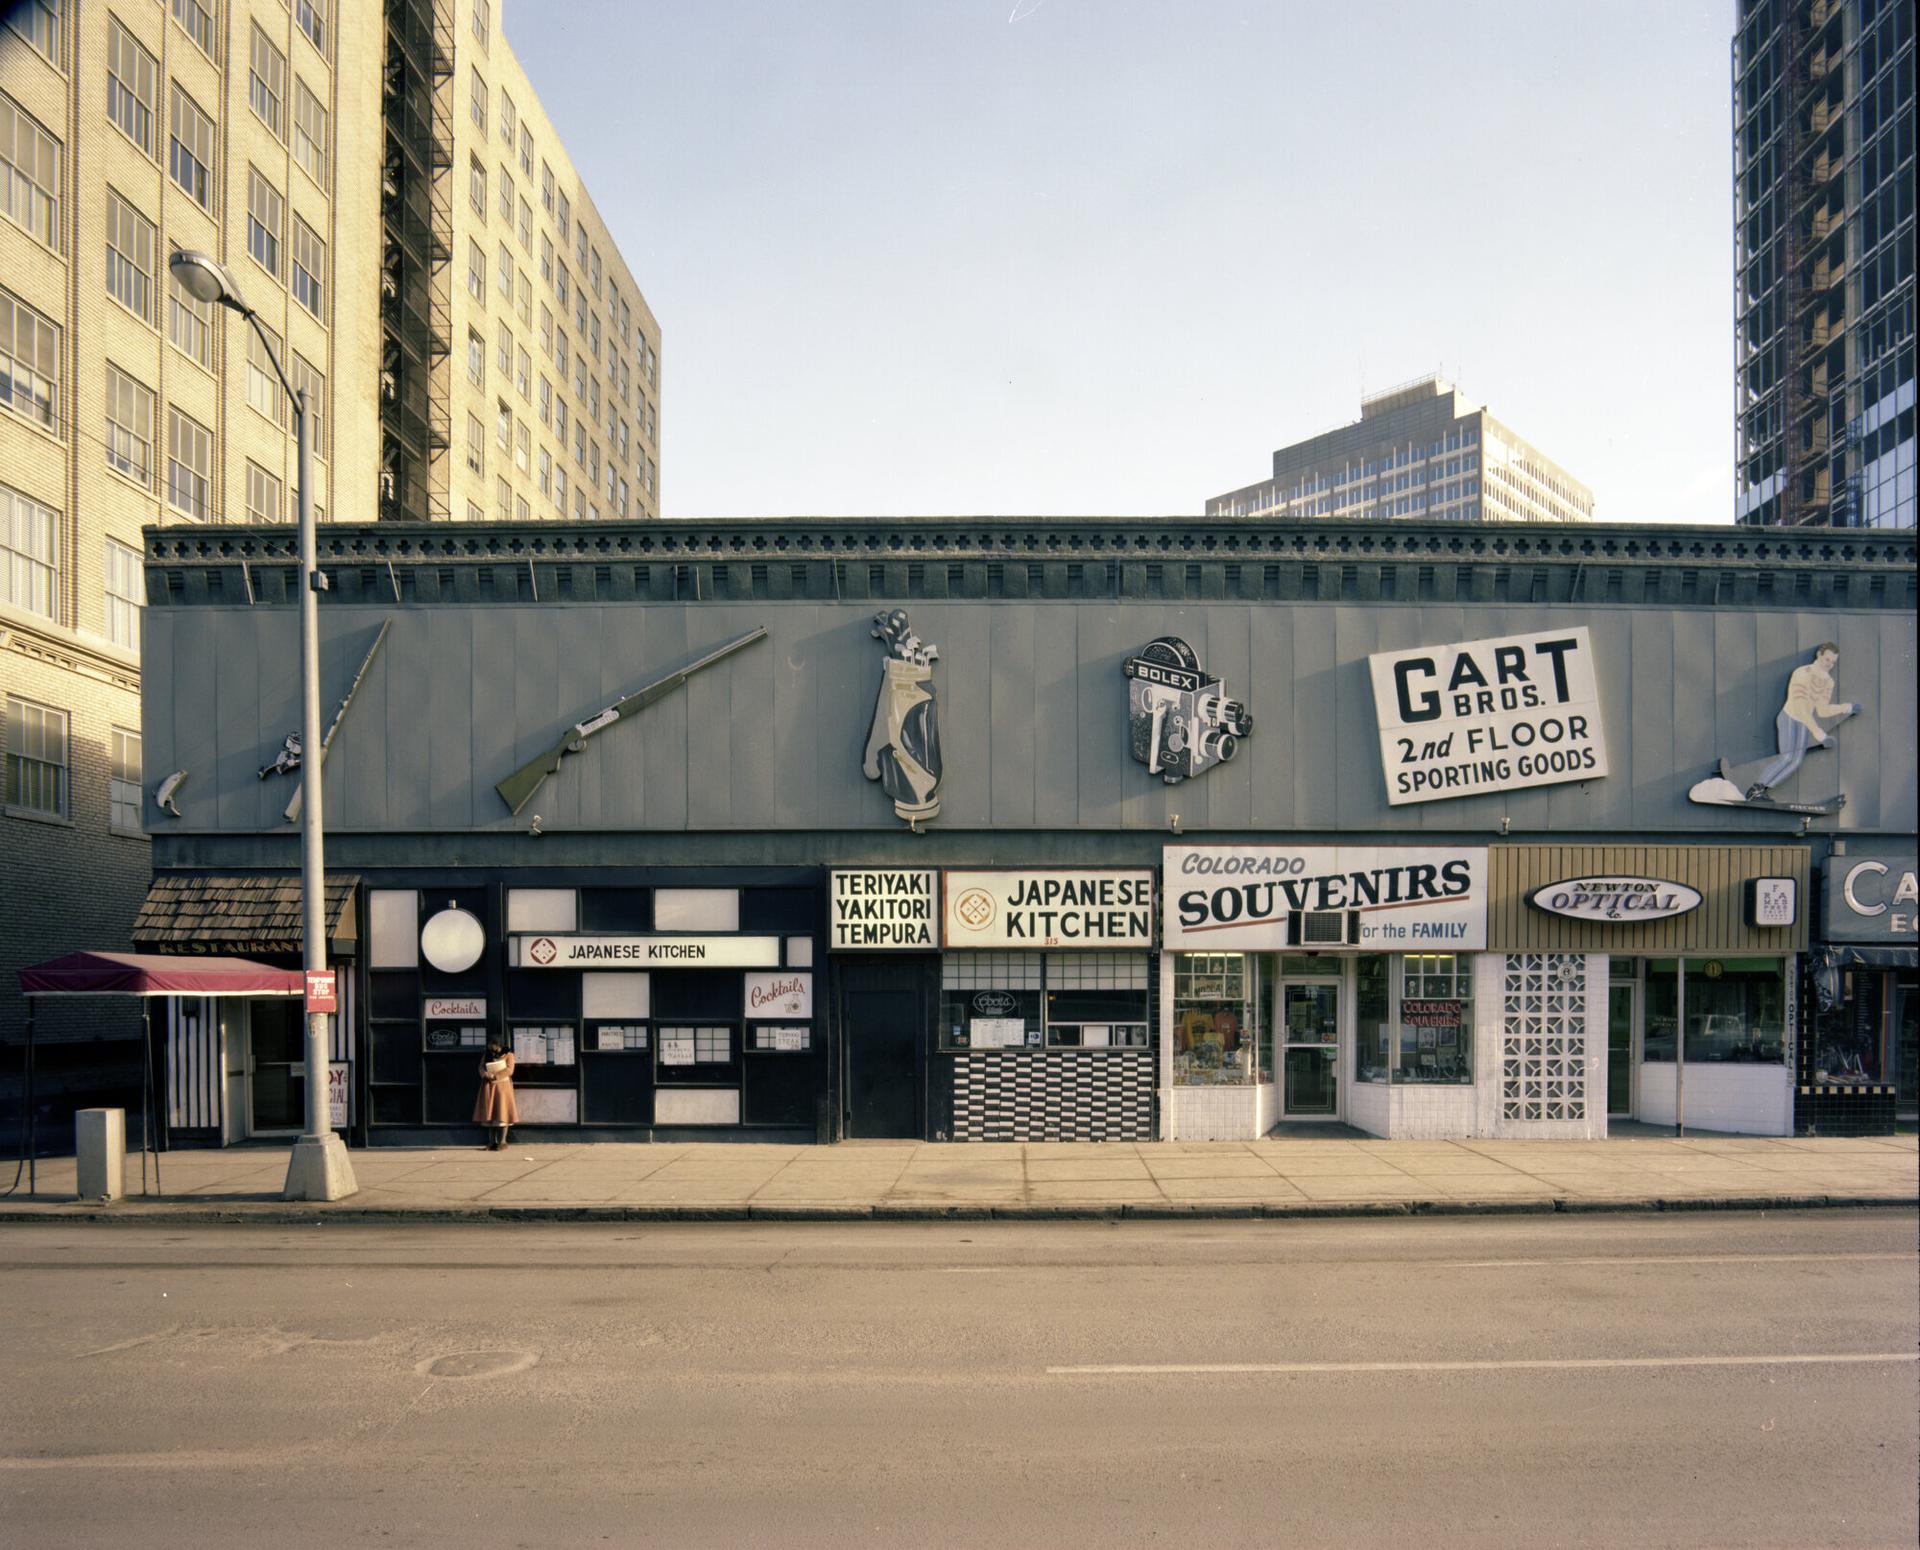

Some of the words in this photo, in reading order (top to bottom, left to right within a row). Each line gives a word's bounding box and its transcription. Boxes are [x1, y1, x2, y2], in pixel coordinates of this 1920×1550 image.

[1138, 665, 1192, 690] BOLEX
[1394, 638, 1578, 724] GART
[1454, 684, 1546, 717] BROS.
[1397, 733, 1453, 764] 2nd
[1468, 715, 1589, 751] FLOOR
[1397, 759, 1511, 794] SPORTING
[1518, 747, 1596, 780] GOODS
[1181, 853, 1306, 875] COLORADO
[836, 873, 930, 895] TERIYAKI
[1007, 880, 1149, 907] JAPANESE
[1178, 860, 1471, 927] SOUVENIRS
[1573, 883, 1660, 893] NEWTON
[837, 898, 931, 920] YAKITORI
[1551, 893, 1680, 910] OPTICAL
[837, 923, 931, 945] TEMPURA
[1007, 911, 1149, 938] KITCHEN
[1382, 922, 1406, 938] the
[1412, 922, 1468, 938] FAMILY
[568, 945, 640, 959] JAPANESE
[648, 945, 705, 958] KITCHEN
[751, 977, 806, 1009] Cocktails
[431, 1000, 480, 1016] Cocktails
[1403, 1001, 1461, 1014] COLORADO
[1404, 1015, 1460, 1026] SOUVENIRS
[1787, 1004, 1796, 1070] OPTICAL
